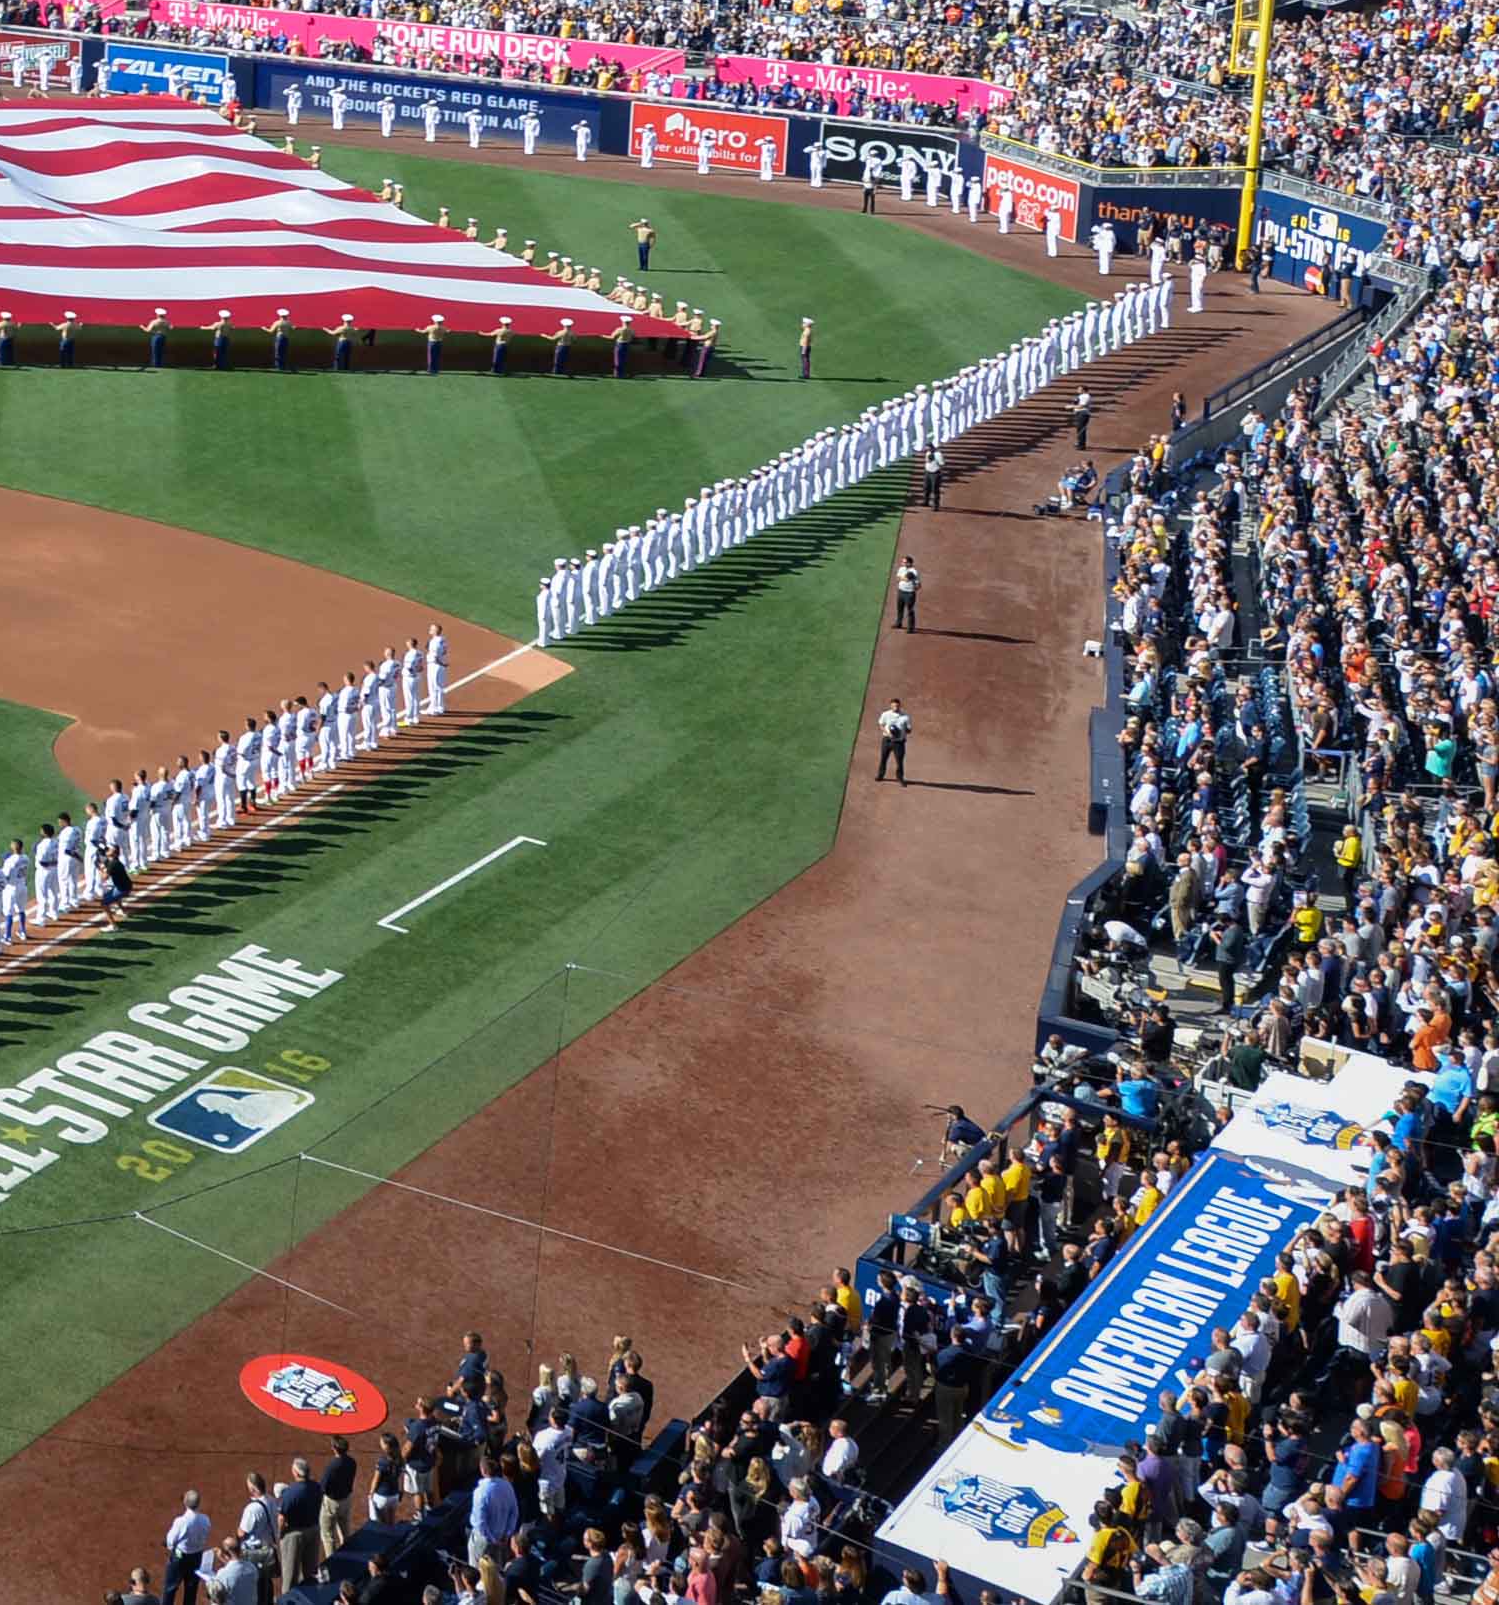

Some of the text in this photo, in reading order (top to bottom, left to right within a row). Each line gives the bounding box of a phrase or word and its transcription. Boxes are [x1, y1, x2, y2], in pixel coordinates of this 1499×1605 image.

[449, 28, 504, 57] RUN
[505, 36, 573, 64] DECK
[112, 57, 225, 84] FALKEN
[305, 74, 335, 89] AND
[338, 78, 369, 93] THE
[372, 81, 446, 102] ROCKET'S
[451, 90, 484, 107] RED
[684, 118, 747, 149] hero
[739, 151, 758, 163] for
[825, 135, 956, 175] SONY
[986, 166, 1076, 213] petco.com
[127, 943, 346, 1053] GAME
[116, 1049, 332, 1183] 20 16
[1051, 1186, 1293, 1424] AMERICAN LEAGUE
